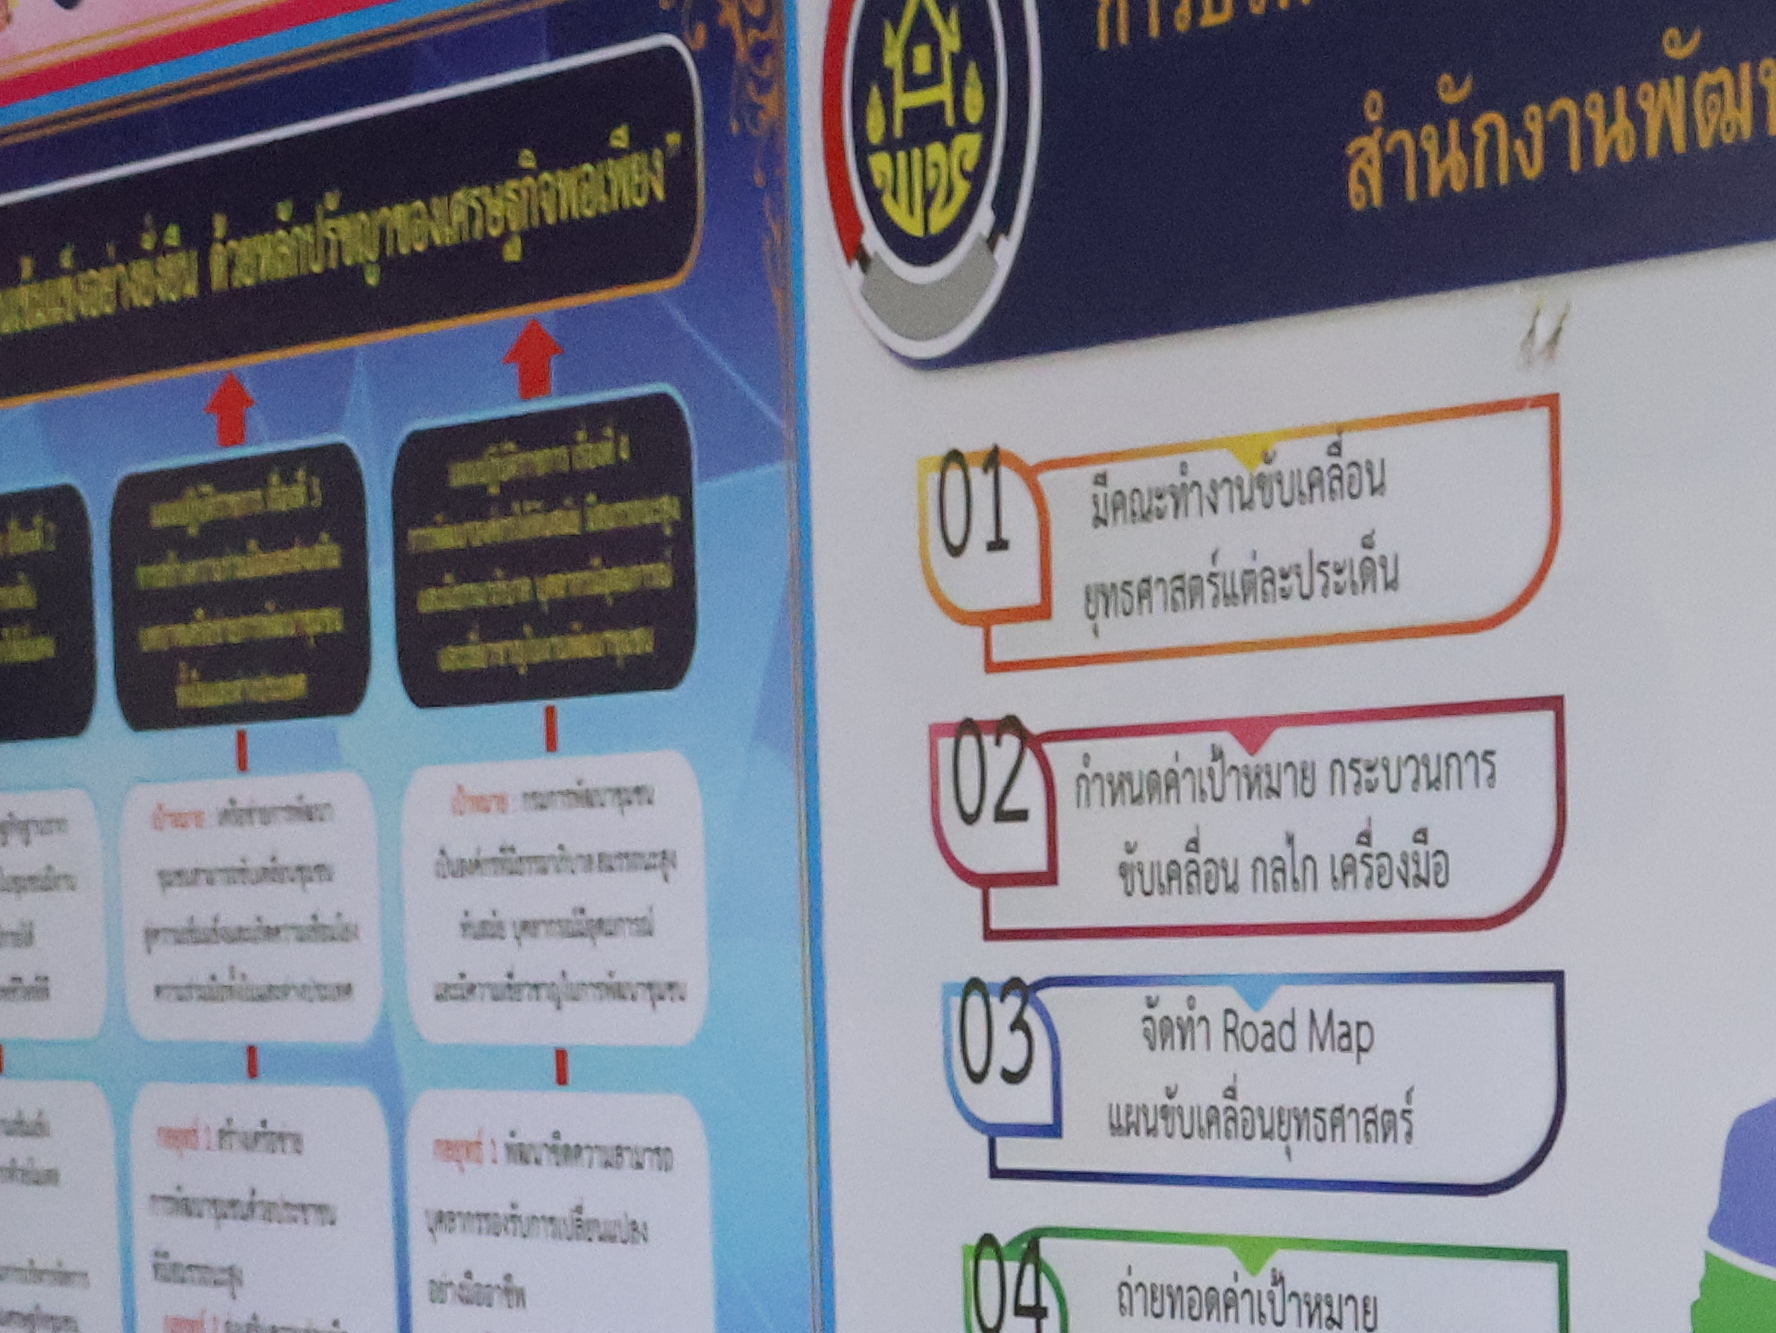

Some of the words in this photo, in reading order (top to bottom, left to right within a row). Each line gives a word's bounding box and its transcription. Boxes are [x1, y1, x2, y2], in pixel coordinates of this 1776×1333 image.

[938, 443, 1010, 558] 01
[1091, 430, 1387, 530] มีคณะทำงานขับเคลื่อน
[1083, 530, 1401, 639] ยุทธศาสตร์แต่ละประเด็น
[950, 714, 1031, 827] 02
[1074, 744, 1318, 811] กำหนดค่าเป้าหมาย
[1329, 747, 1497, 801] กระบวนการ
[1118, 826, 1240, 898] ขับเคลื่อน
[1250, 833, 1319, 893] กลไก
[1329, 817, 1451, 894] เครื่องมือ
[958, 975, 1035, 1085] 03
[1141, 995, 1212, 1056] จัดทำ
[1224, 1007, 1298, 1054] Road
[1308, 1006, 1375, 1064] Map
[1108, 1073, 1416, 1161] แผนขับเคลื่อนยุทธศาสตร์
[1116, 1264, 1379, 1333] ถ่ายทอดค่าเป้าหมาย
